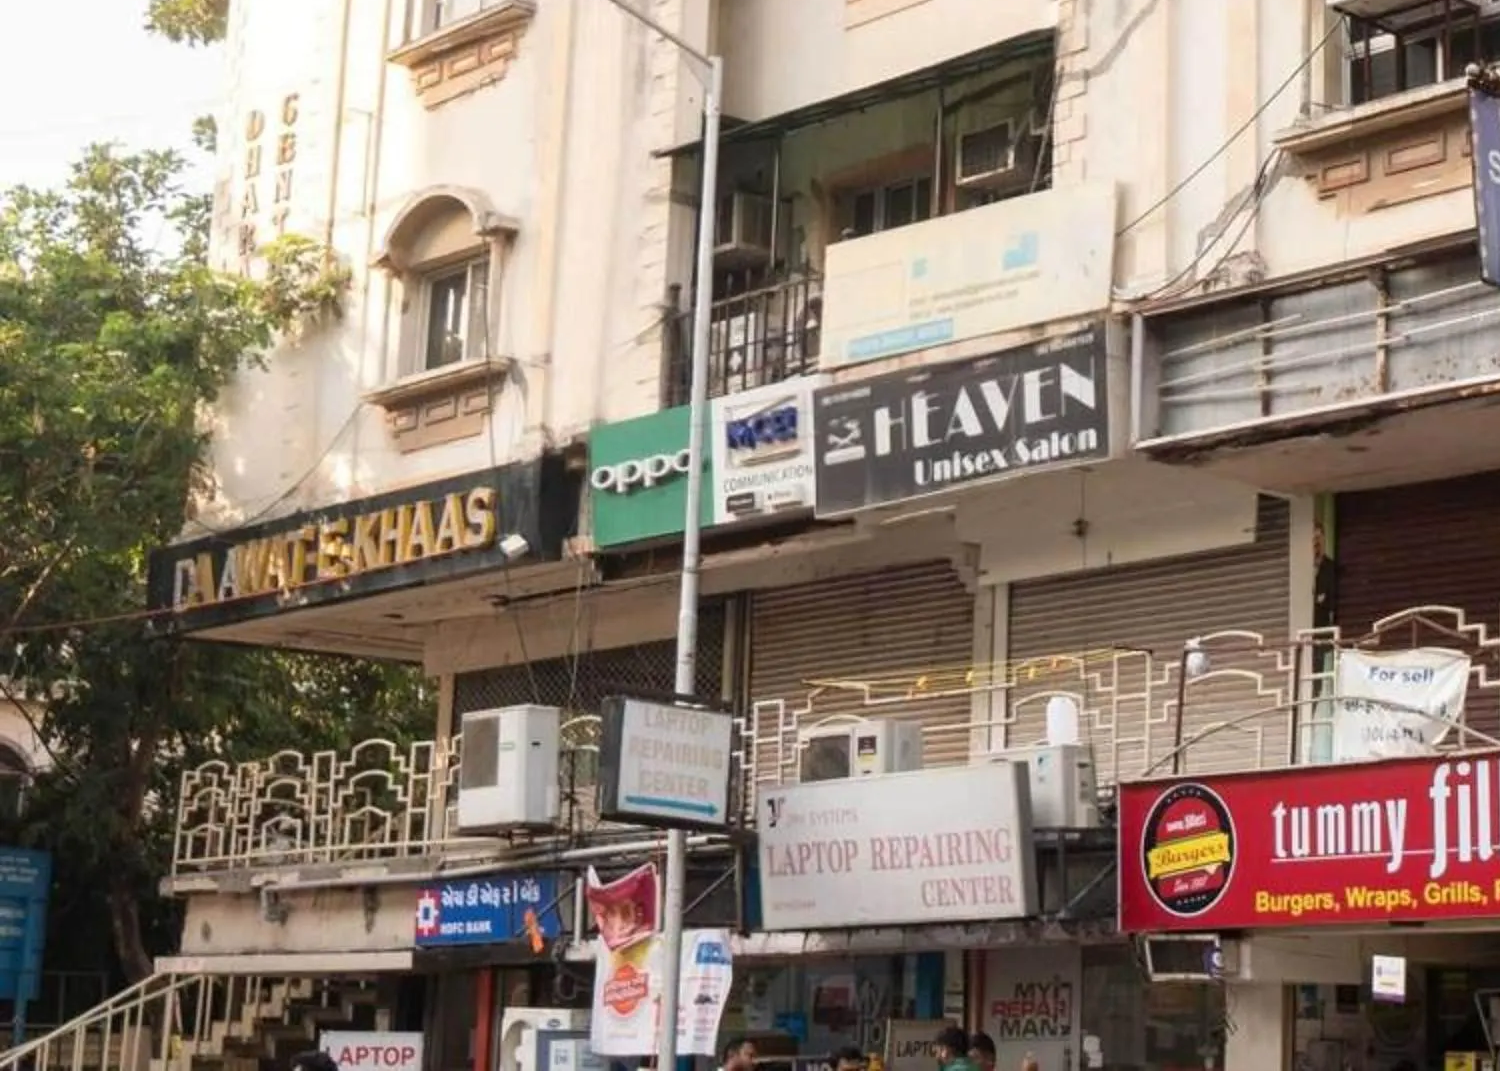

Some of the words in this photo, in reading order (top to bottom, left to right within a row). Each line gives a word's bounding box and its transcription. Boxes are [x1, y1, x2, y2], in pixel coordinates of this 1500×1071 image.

[873, 354, 1097, 456] HEAVEN
[591, 448, 693, 493] oppo
[914, 442, 1009, 486] Unisex
[1015, 428, 1098, 464] Salon
[723, 463, 813, 494] COMMUNICATION
[1369, 666, 1397, 680] For
[1401, 669, 1435, 683] sell
[645, 708, 714, 735] LAPTOP
[629, 735, 722, 769] REPAIRING
[641, 770, 708, 797] CENTER
[1272, 799, 1407, 874] tummy
[767, 838, 859, 878] LAPTOP
[870, 829, 1012, 872] REPAIRING
[921, 876, 1015, 908] CENTER
[1255, 892, 1340, 917] Burgers,
[1345, 886, 1419, 911] Wraps,
[1424, 881, 1488, 906] Grills,
[466, 920, 492, 934] BANK
[1014, 982, 1051, 998] MY
[1000, 1017, 1057, 1037] MAN
[897, 1041, 938, 1057] LAPTO
